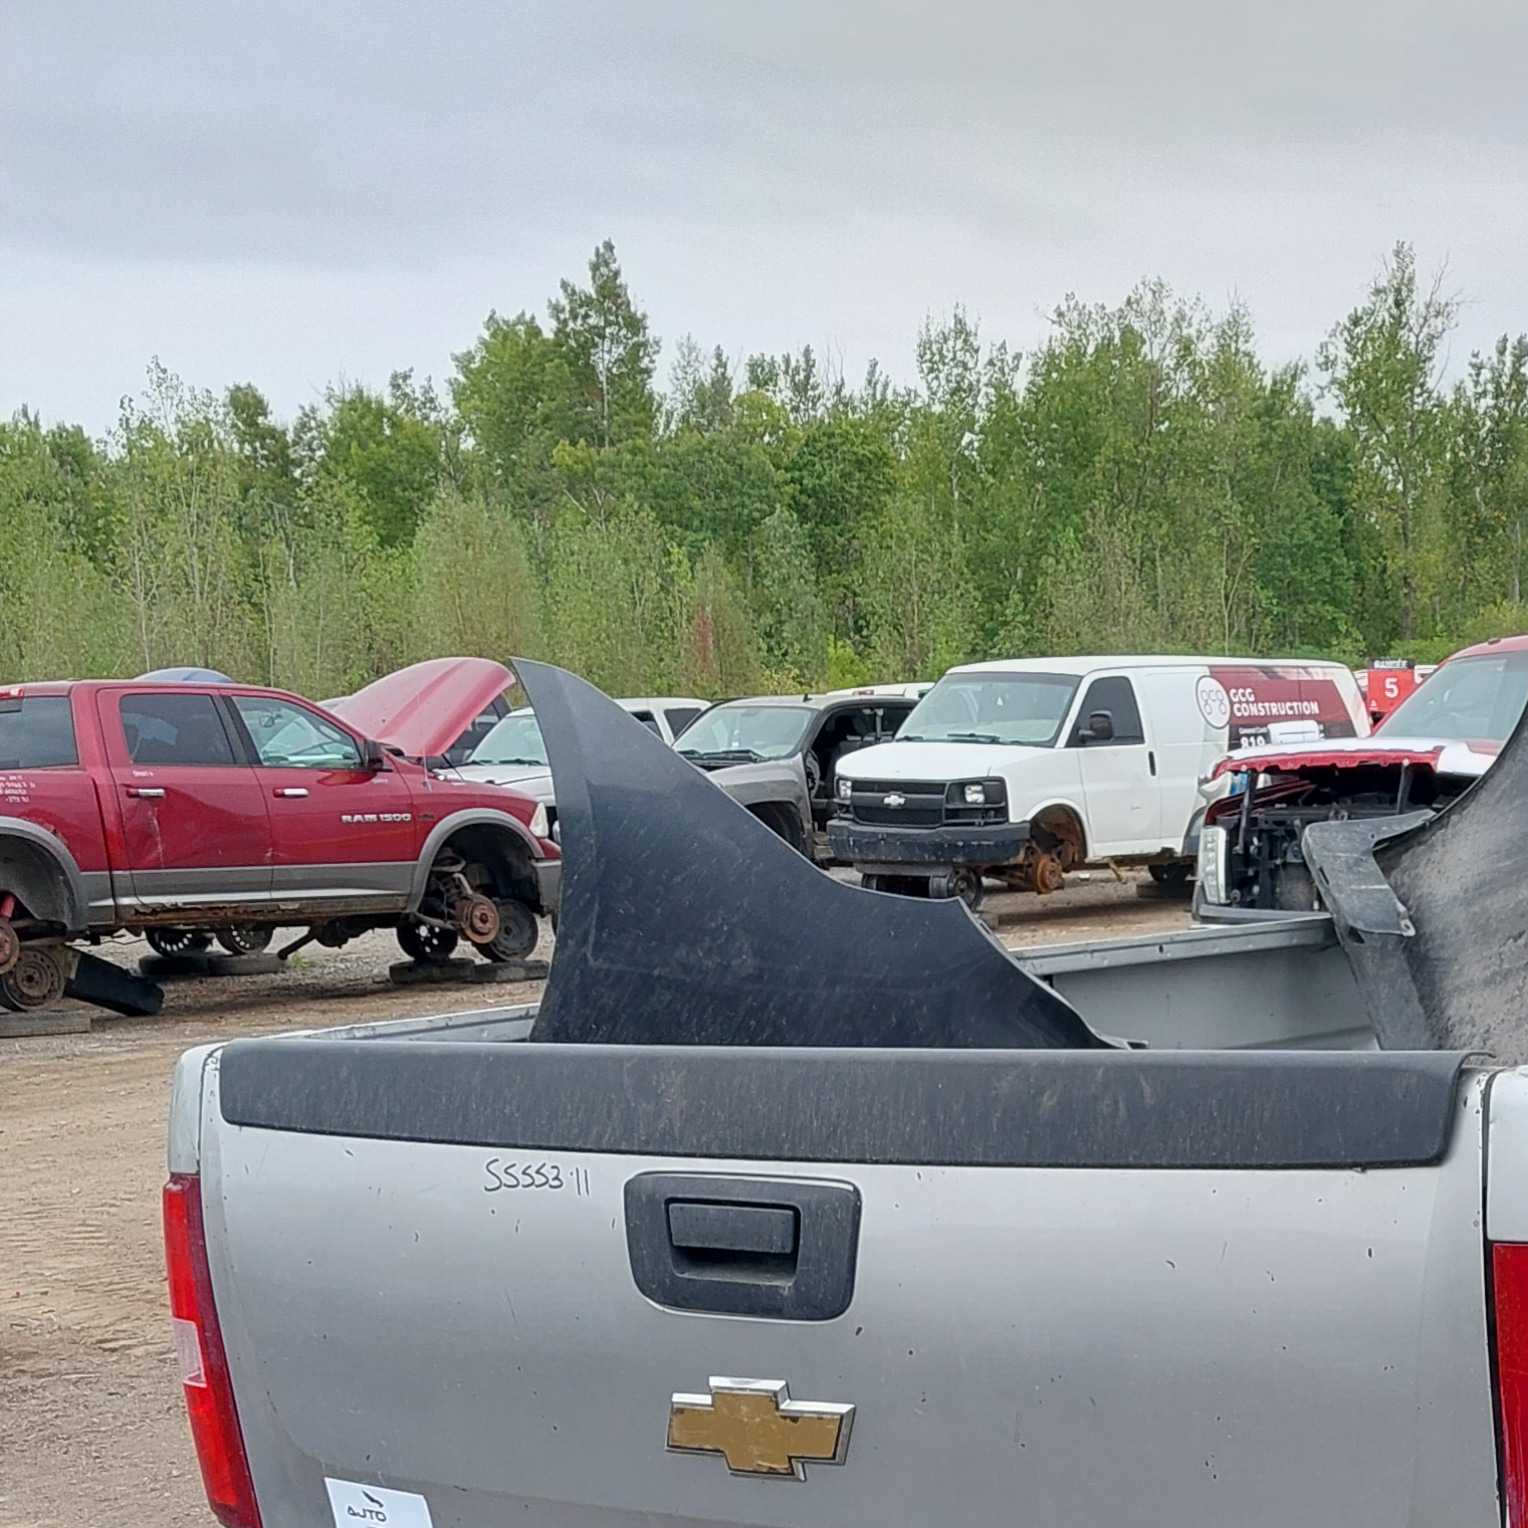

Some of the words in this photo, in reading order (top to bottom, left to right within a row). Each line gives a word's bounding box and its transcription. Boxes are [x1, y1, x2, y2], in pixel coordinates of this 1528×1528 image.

[1384, 677, 1399, 698] 5
[1233, 701, 1320, 717] CONSTRUCTION
[341, 815, 377, 823] RAM
